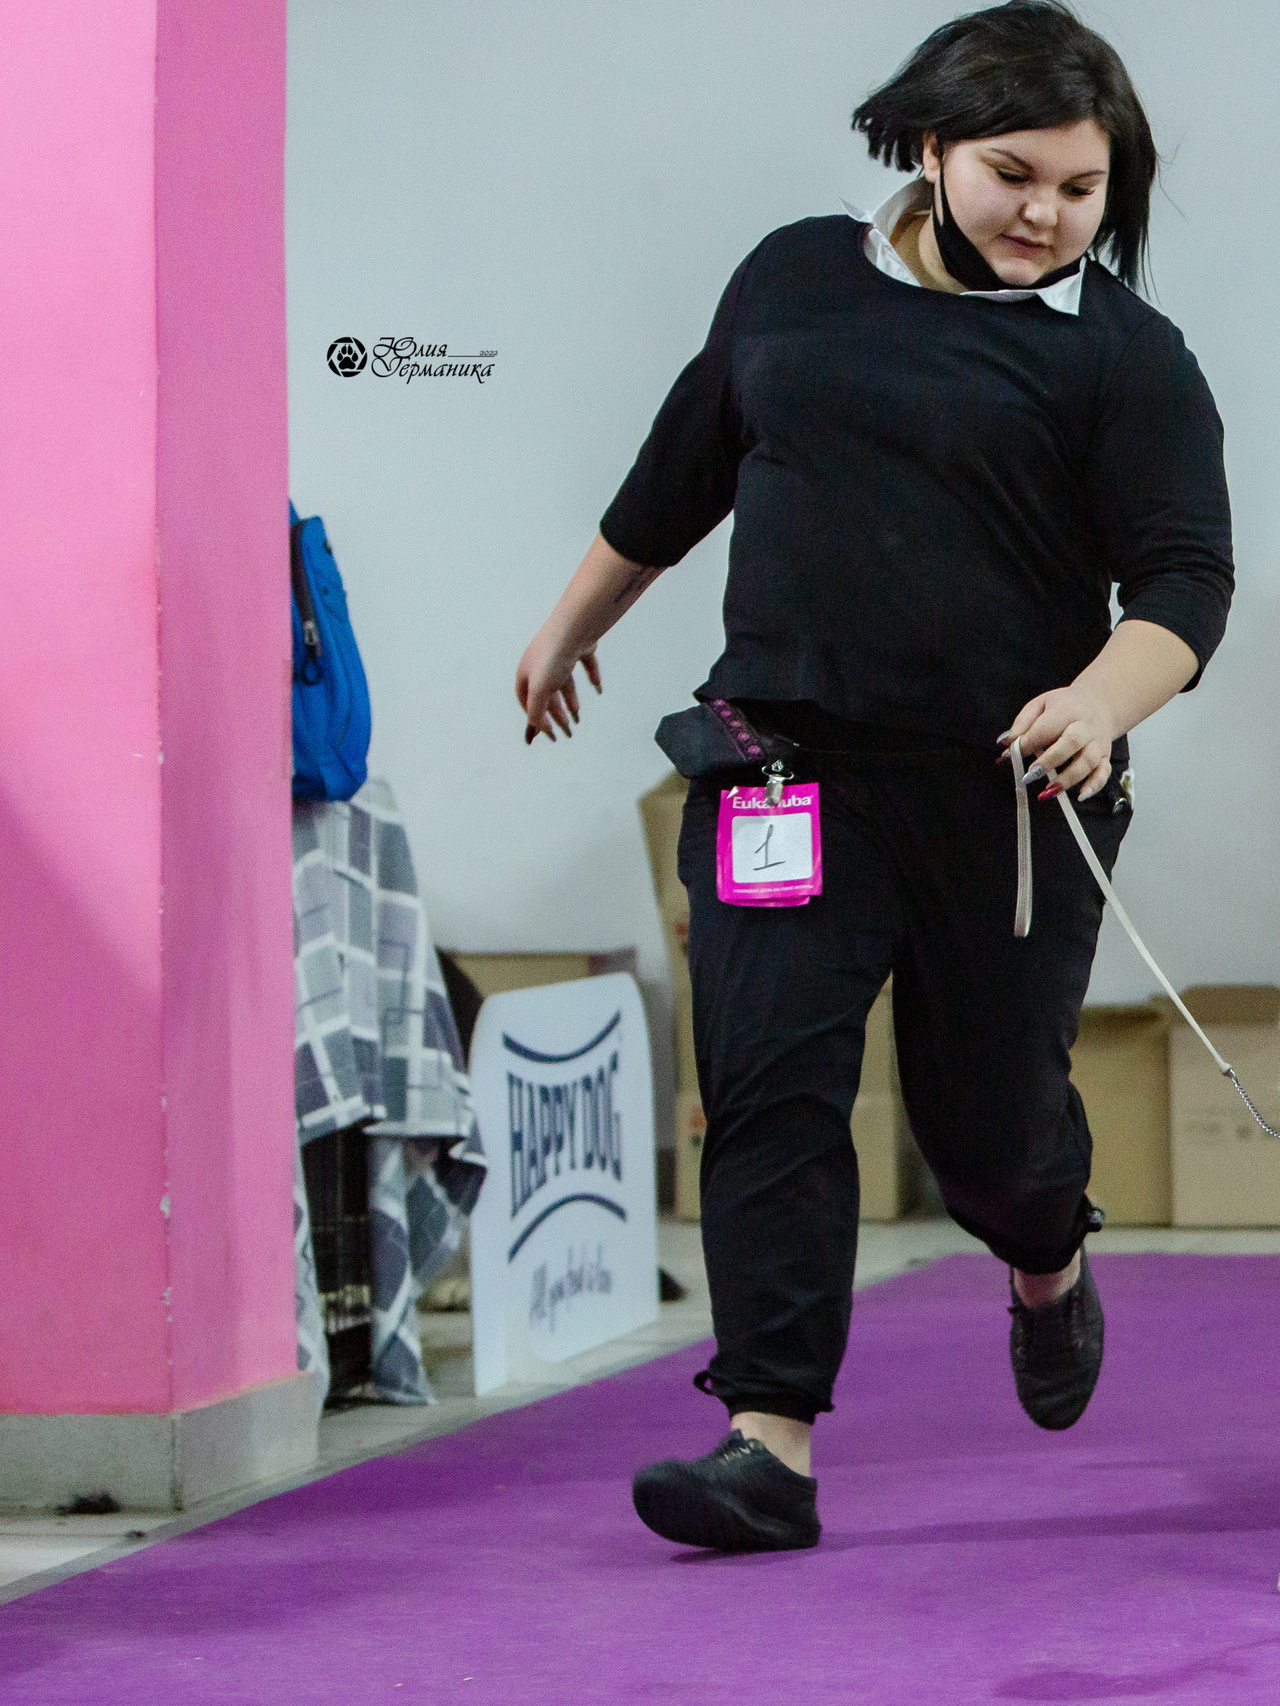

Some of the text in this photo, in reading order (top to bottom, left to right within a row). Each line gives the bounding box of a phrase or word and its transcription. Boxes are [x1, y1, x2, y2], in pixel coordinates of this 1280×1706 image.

[753, 823, 786, 871] 1
[507, 1050, 622, 1219] HAPPY DOG
